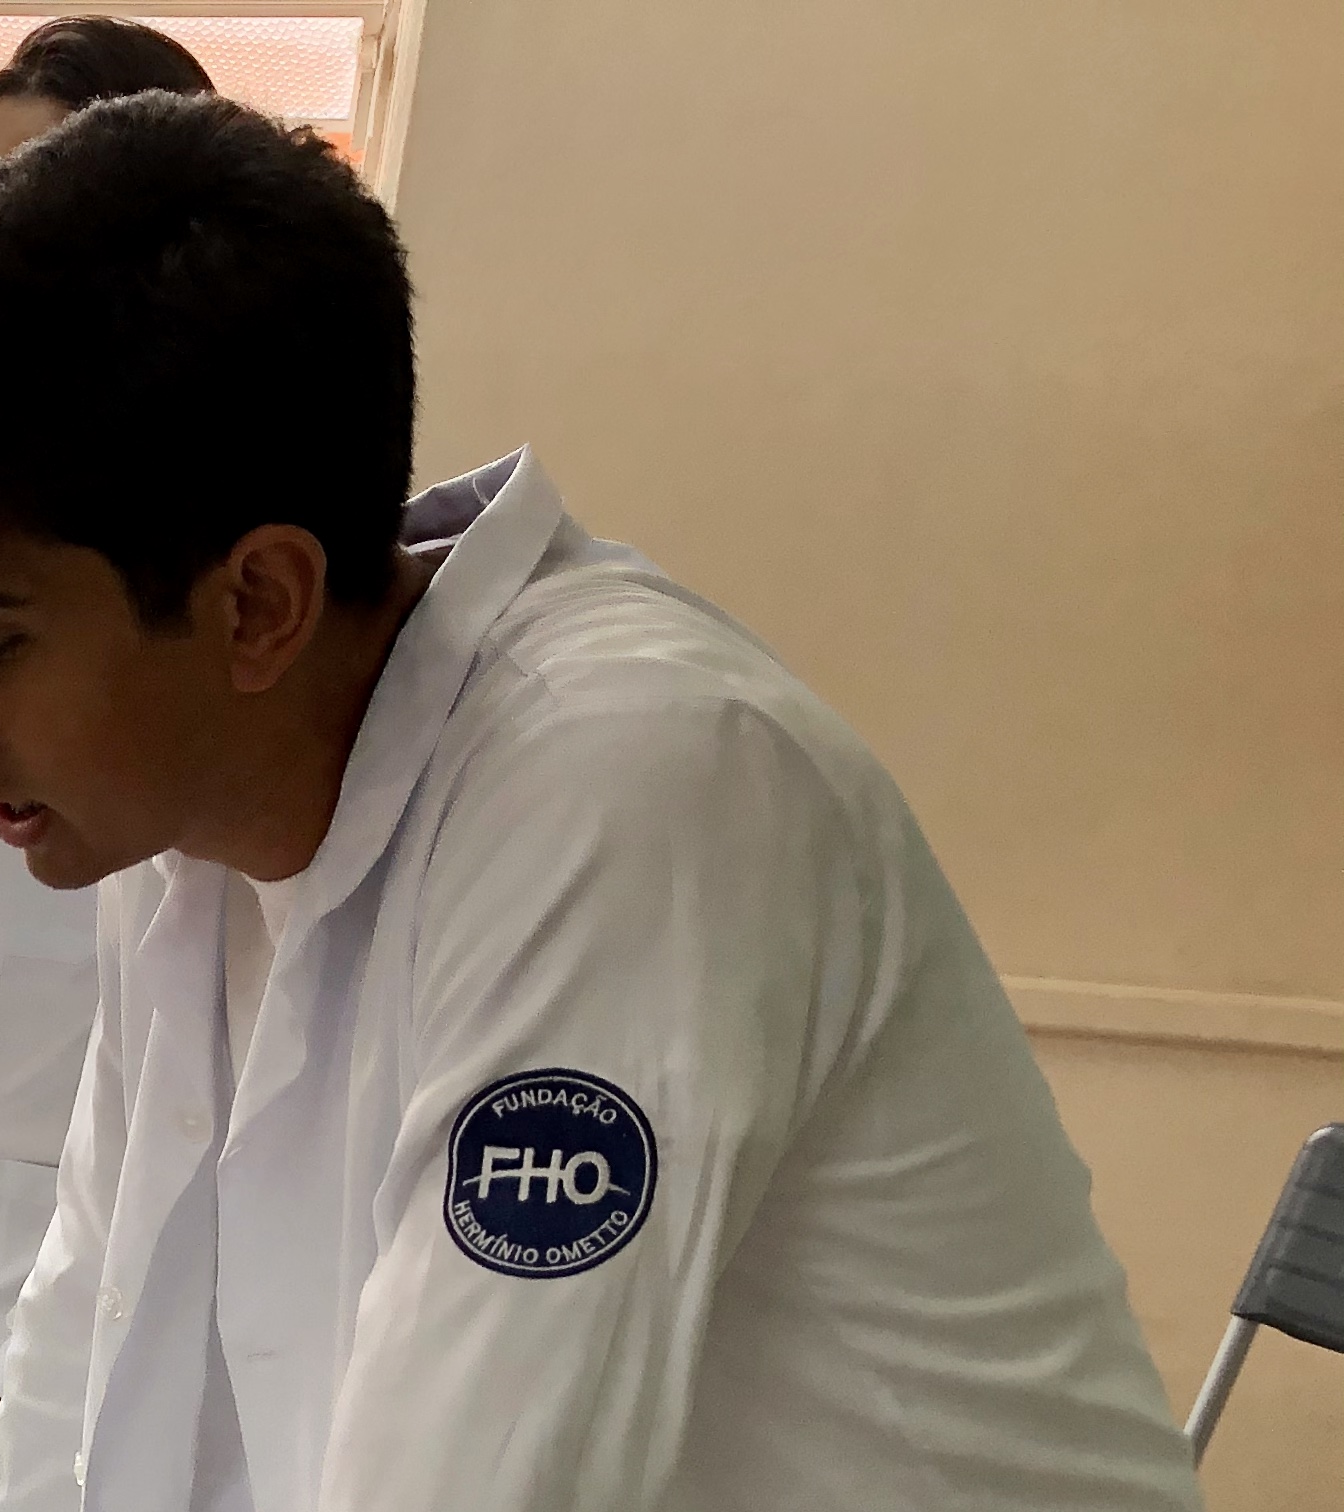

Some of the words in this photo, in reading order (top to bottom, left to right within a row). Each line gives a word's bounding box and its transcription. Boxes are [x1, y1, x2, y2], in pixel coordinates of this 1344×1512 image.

[492, 1088, 618, 1124] FUNDAÇÃO
[477, 1145, 611, 1205] FHO
[453, 1199, 539, 1264] HERMÍNIO
[546, 1210, 628, 1264] OMETTO
